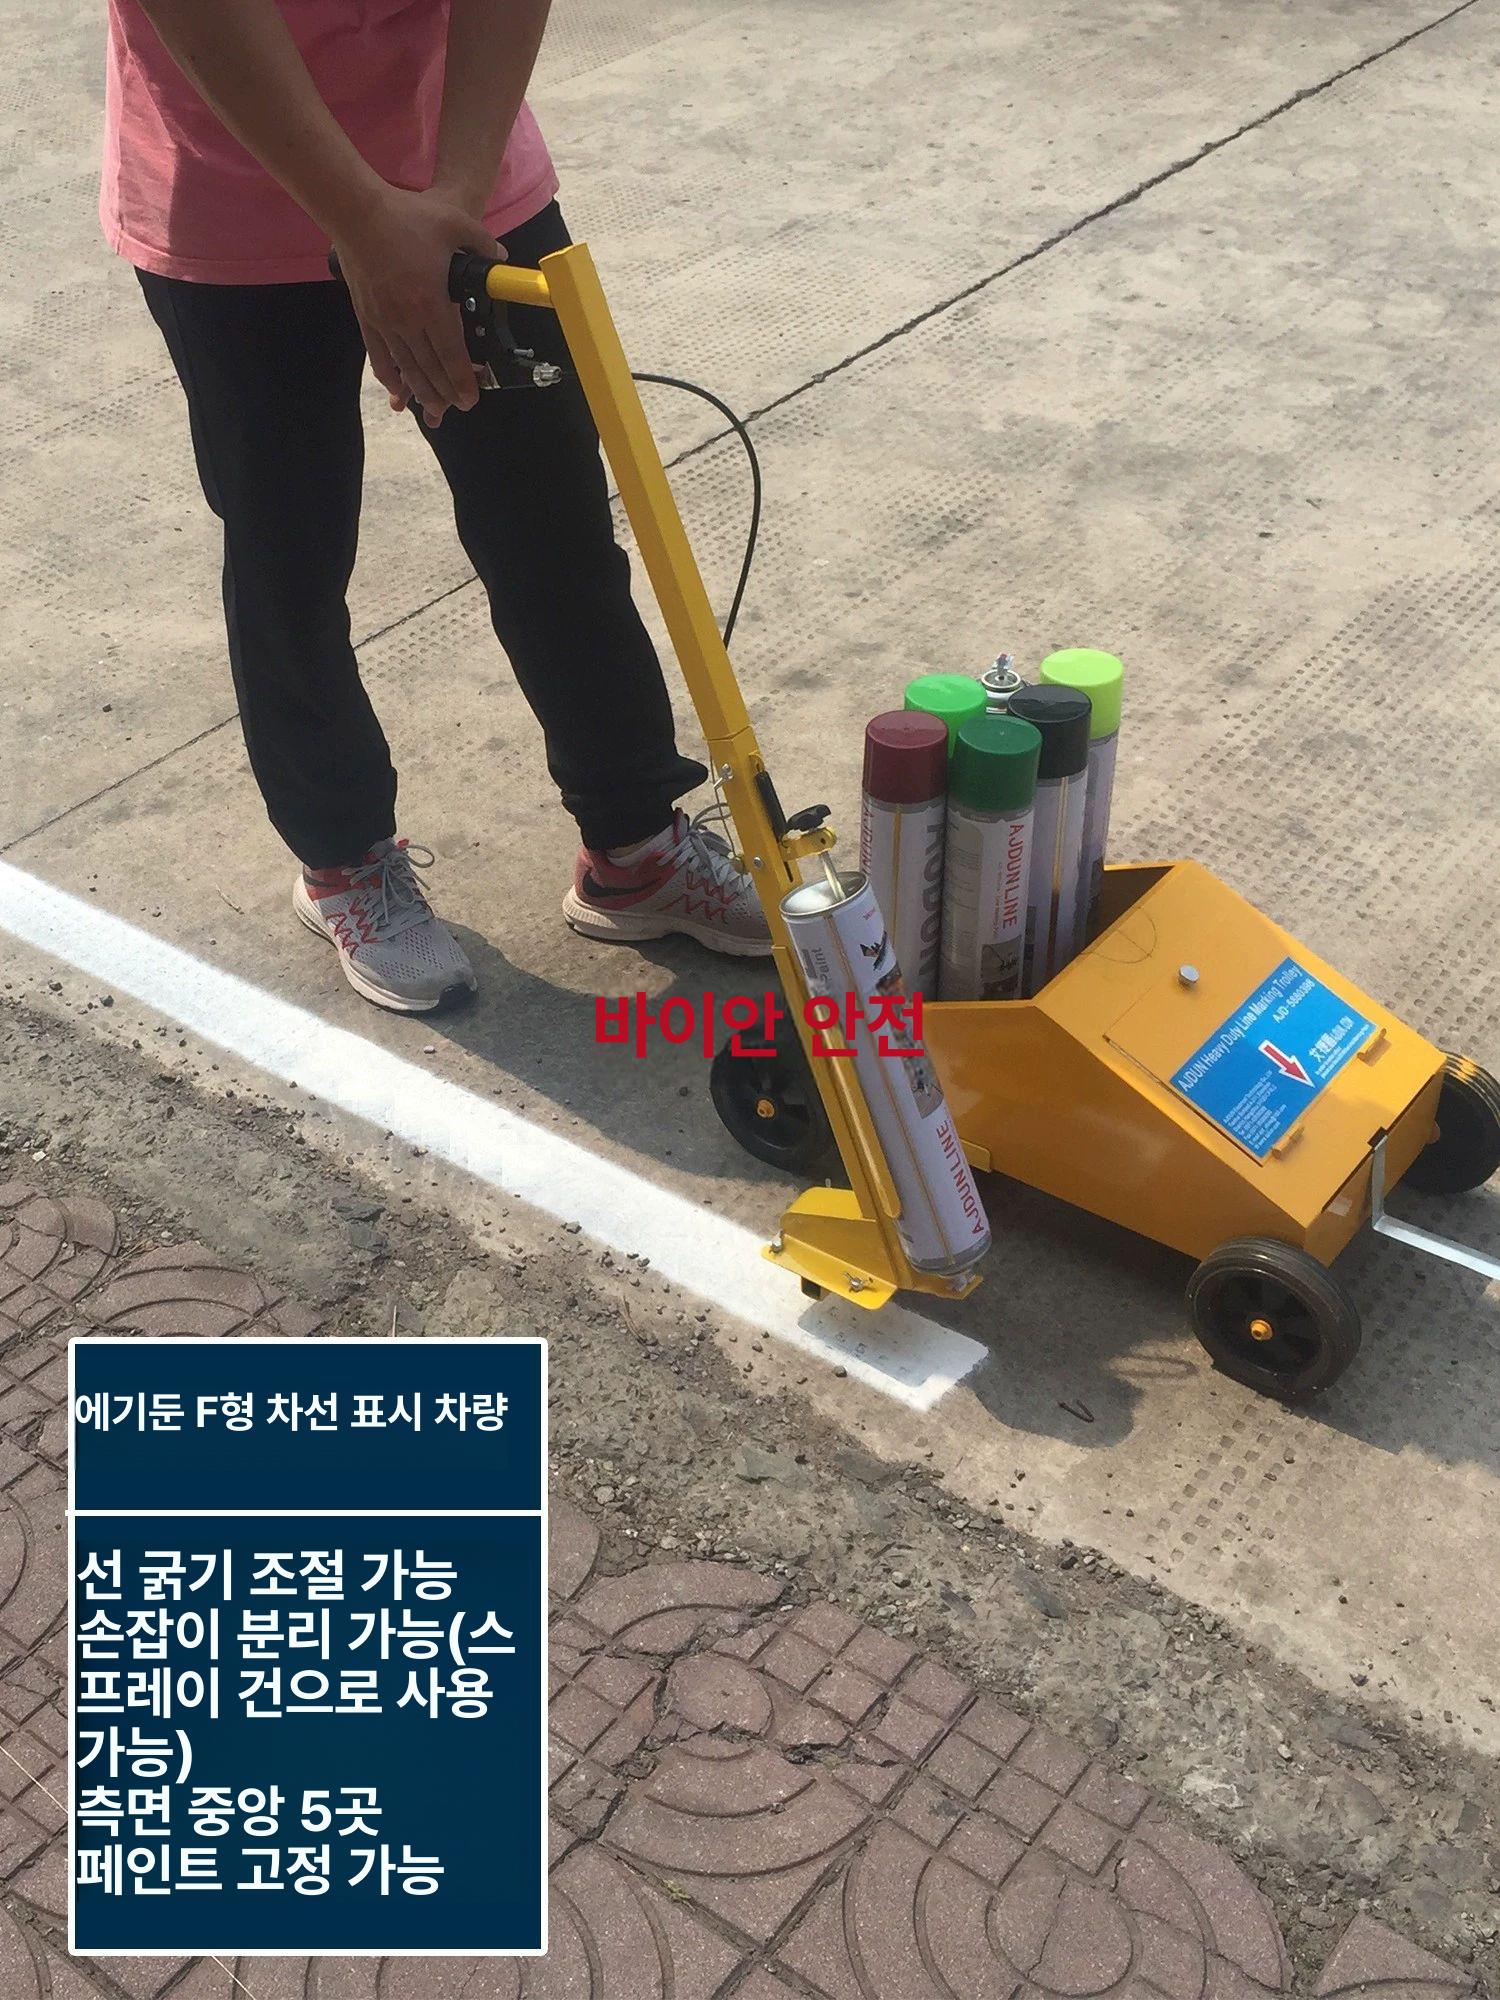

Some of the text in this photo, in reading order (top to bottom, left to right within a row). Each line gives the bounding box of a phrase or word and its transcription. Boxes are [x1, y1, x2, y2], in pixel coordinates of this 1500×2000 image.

[1178, 965, 1304, 1092] AJDUN Heavy Duty Line Marking Trolley
